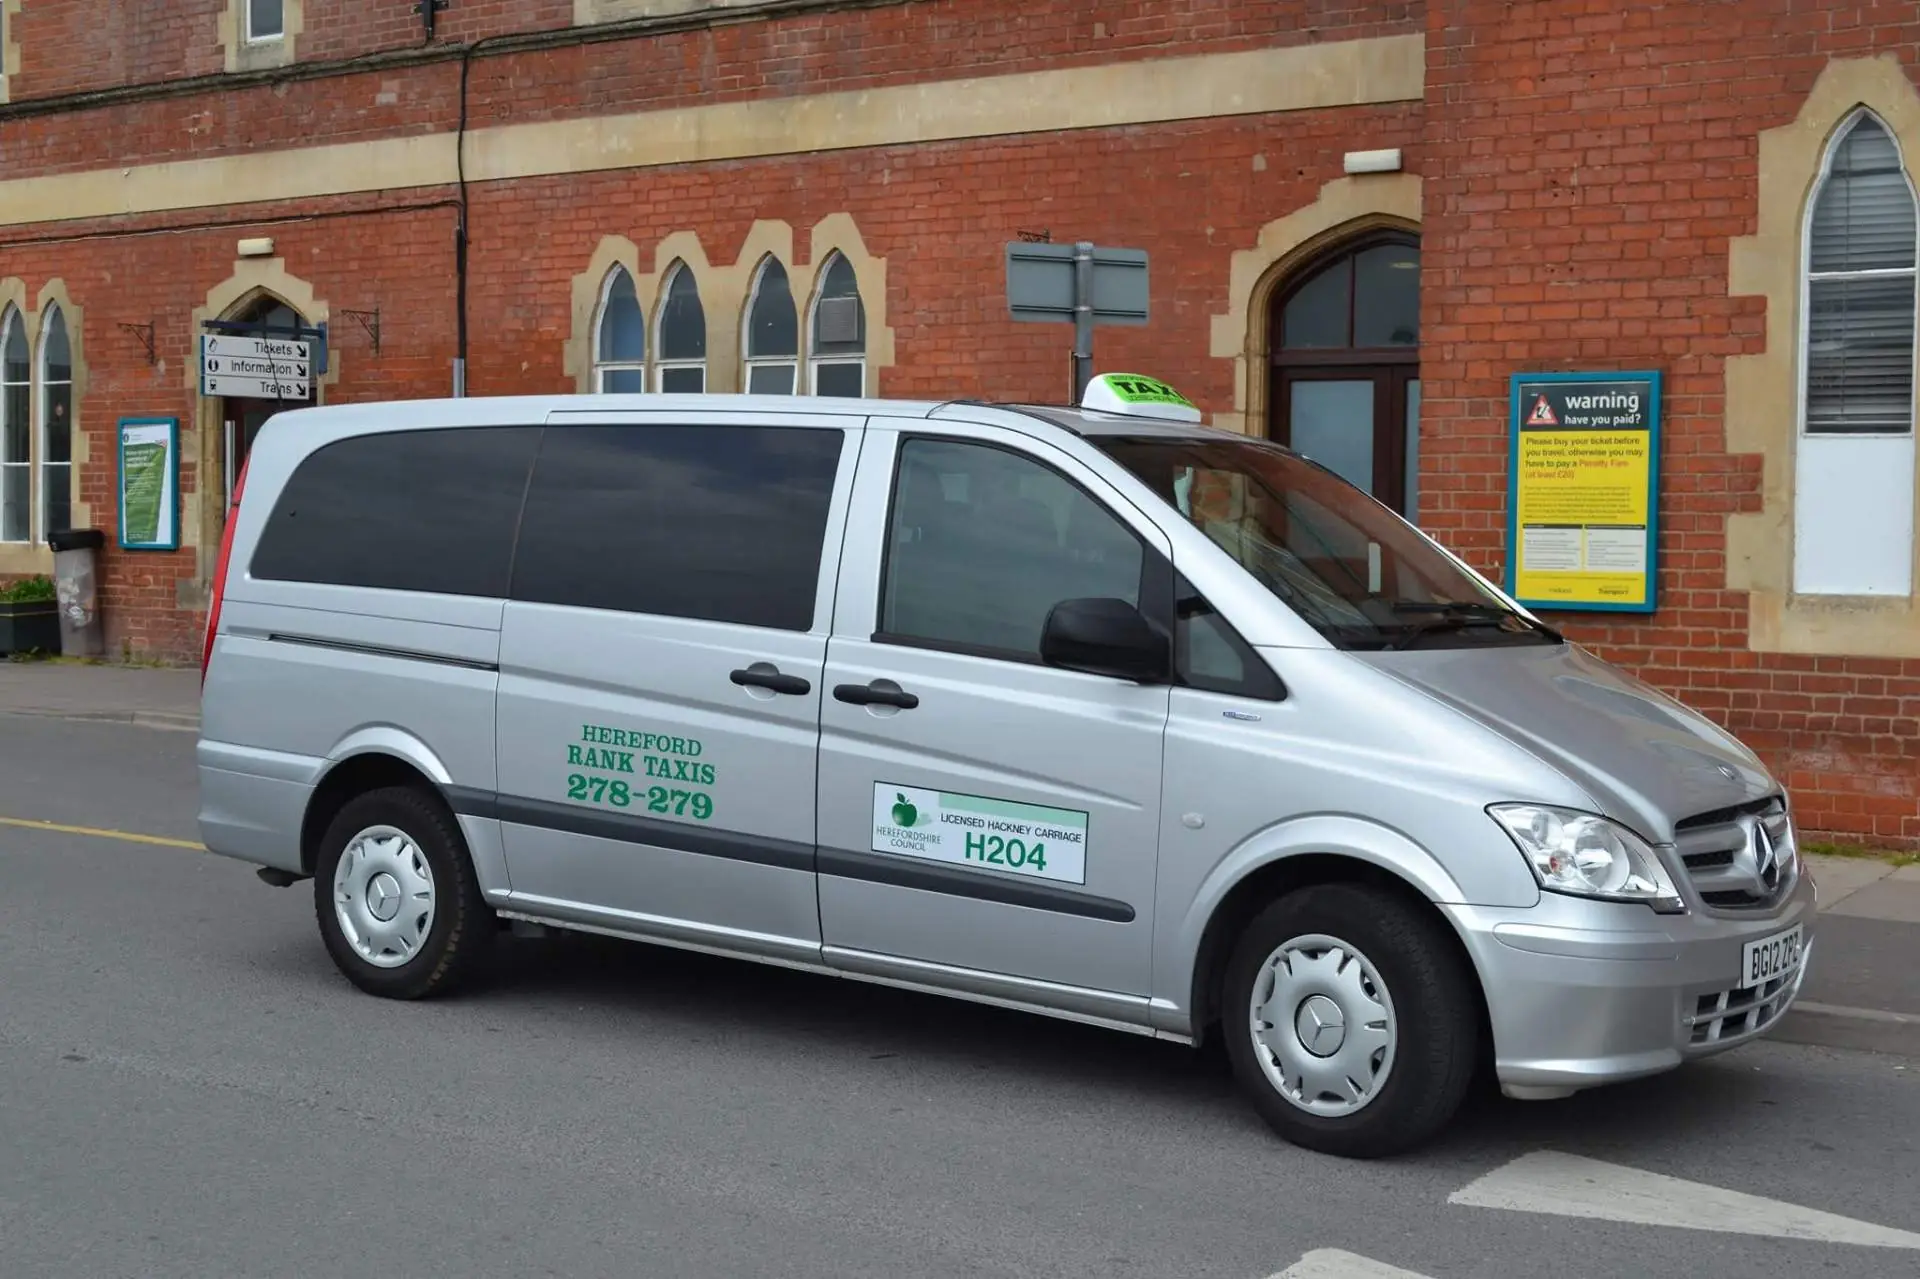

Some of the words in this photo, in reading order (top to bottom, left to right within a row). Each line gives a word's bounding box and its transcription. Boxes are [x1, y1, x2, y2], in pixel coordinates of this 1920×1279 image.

[254, 341, 293, 356] Tickets
[260, 381, 292, 394] Trans
[1564, 390, 1640, 413] warning
[1564, 414, 1589, 425] have
[1591, 416, 1611, 427] you
[1613, 413, 1642, 427] paid?
[1526, 437, 1553, 445] Please
[1554, 437, 1568, 447] buy
[1571, 438, 1588, 447] your
[1590, 437, 1613, 445] ticket
[1614, 436, 1640, 445] before
[1526, 449, 1541, 458] you
[1567, 448, 1607, 457] otherwise
[1609, 449, 1624, 458] you
[1625, 449, 1644, 458] may
[1525, 459, 1545, 468] have
[1546, 460, 1555, 468] to
[1556, 460, 1570, 469] pay
[582, 724, 702, 757] HEREFORD
[567, 744, 635, 773] RANK
[643, 755, 715, 785] TAXIS
[567, 773, 713, 820] 278-279
[876, 826, 942, 845] HEREFORDSHIRE
[940, 812, 985, 828] LICENSED
[987, 820, 1031, 836] HACKNEY
[1034, 827, 1082, 843] CARRIAGE
[890, 838, 926, 852] COUNCIL
[965, 831, 1047, 871] H204
